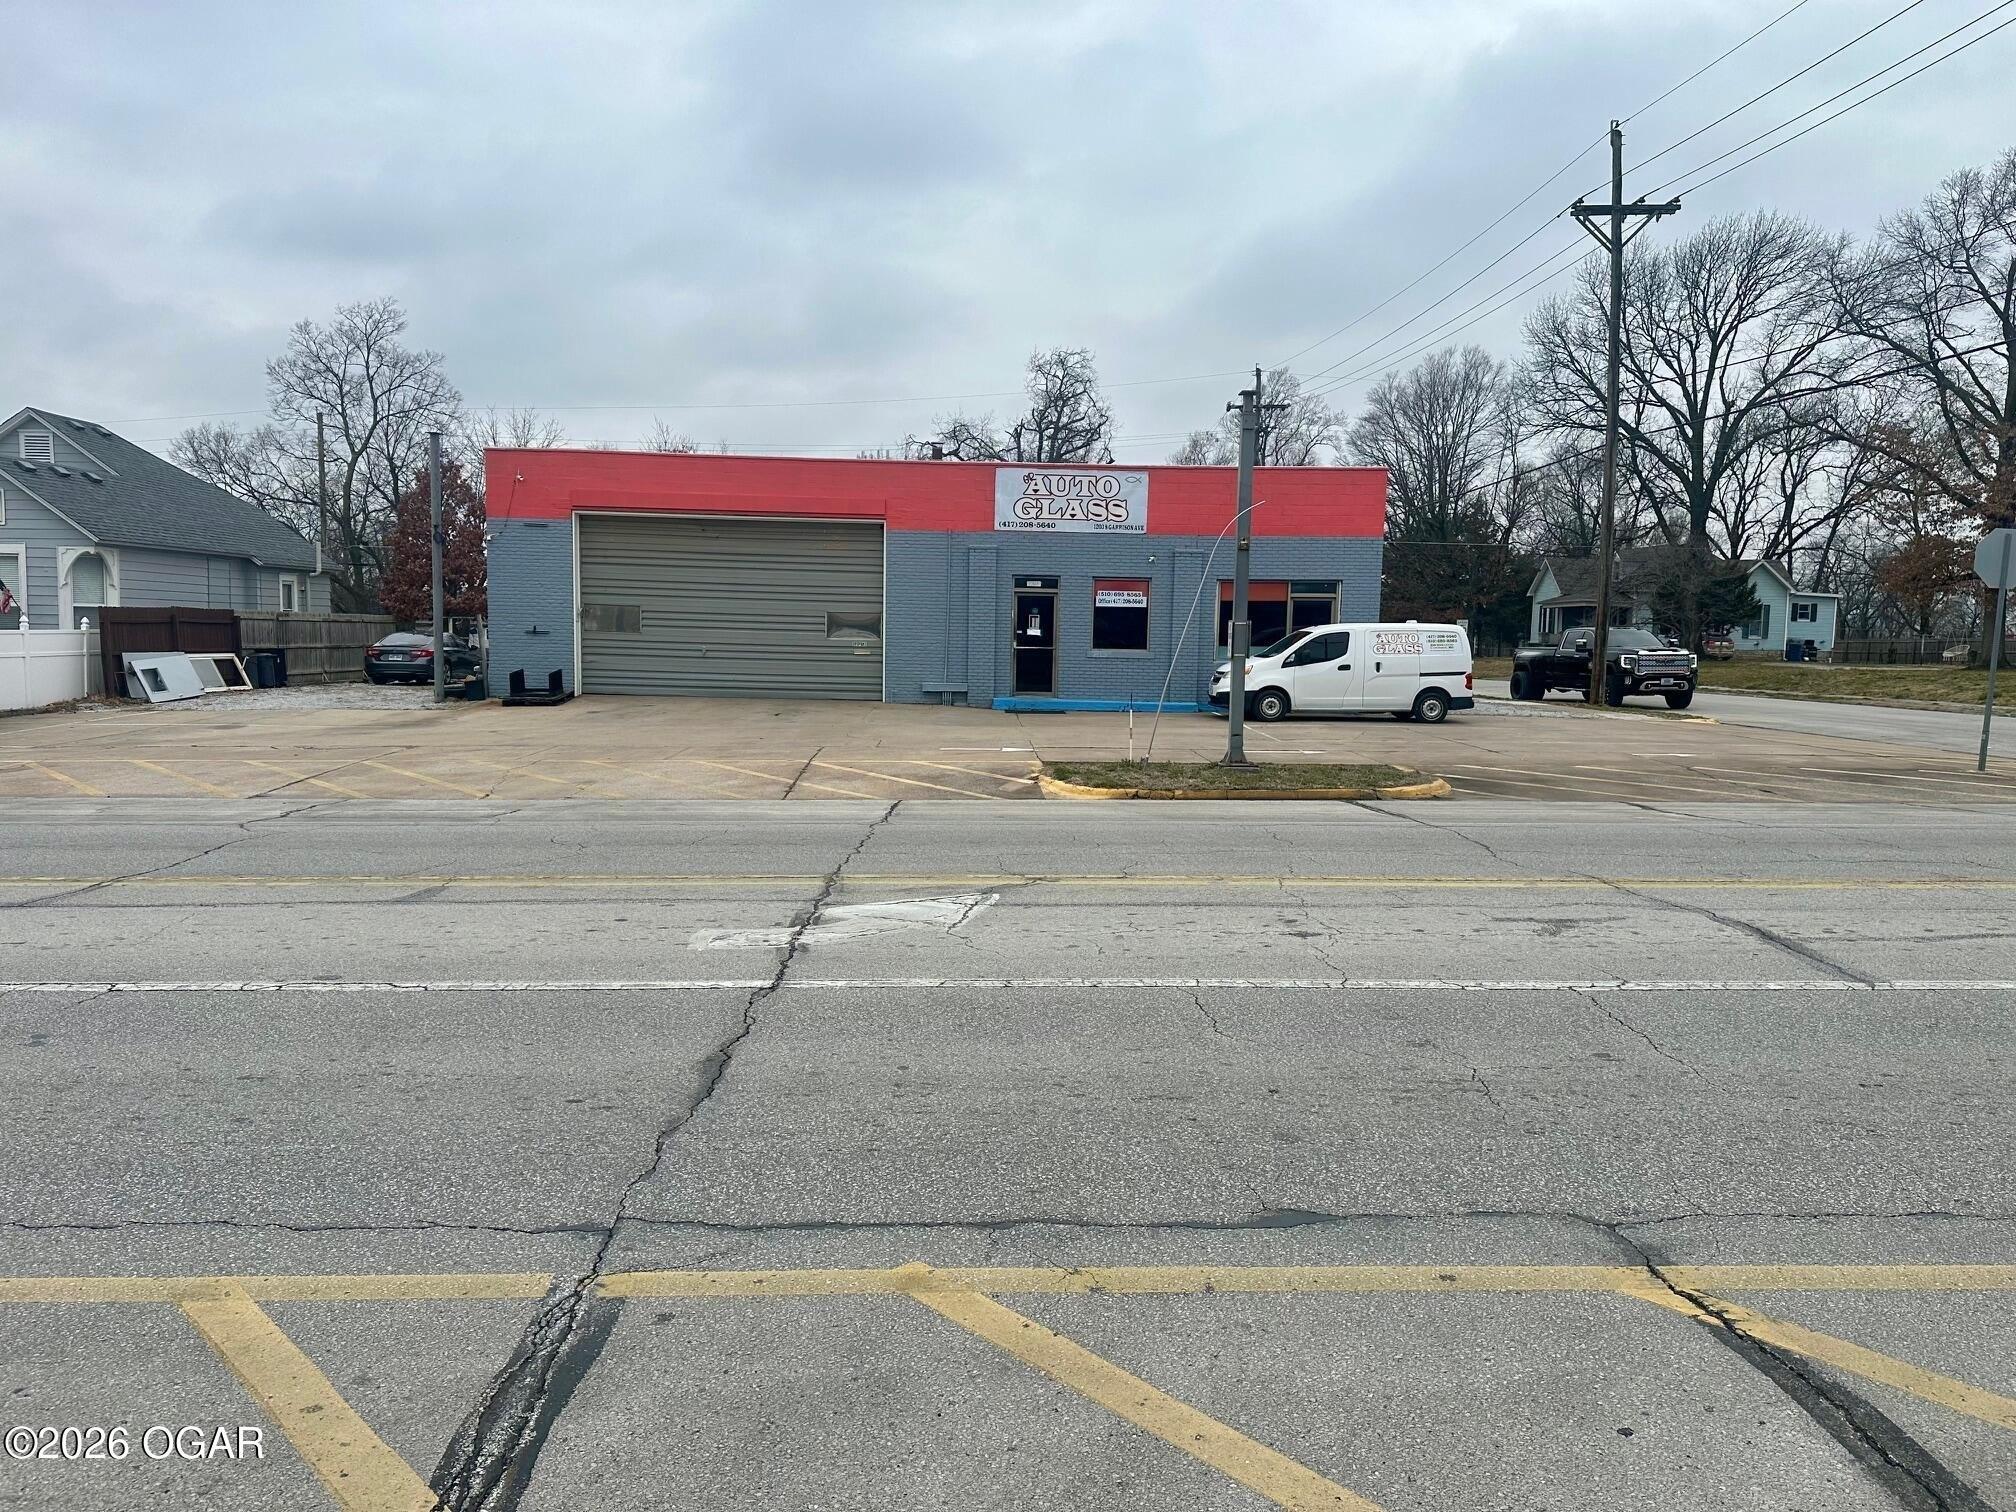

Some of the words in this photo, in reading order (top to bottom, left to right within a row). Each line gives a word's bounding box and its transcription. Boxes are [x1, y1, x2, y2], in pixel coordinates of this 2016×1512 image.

[1023, 473, 1121, 498] AUTO
[1013, 497, 1129, 522] GLASS
[1377, 633, 1419, 644] AUTO
[1373, 643, 1424, 655] GLASS
